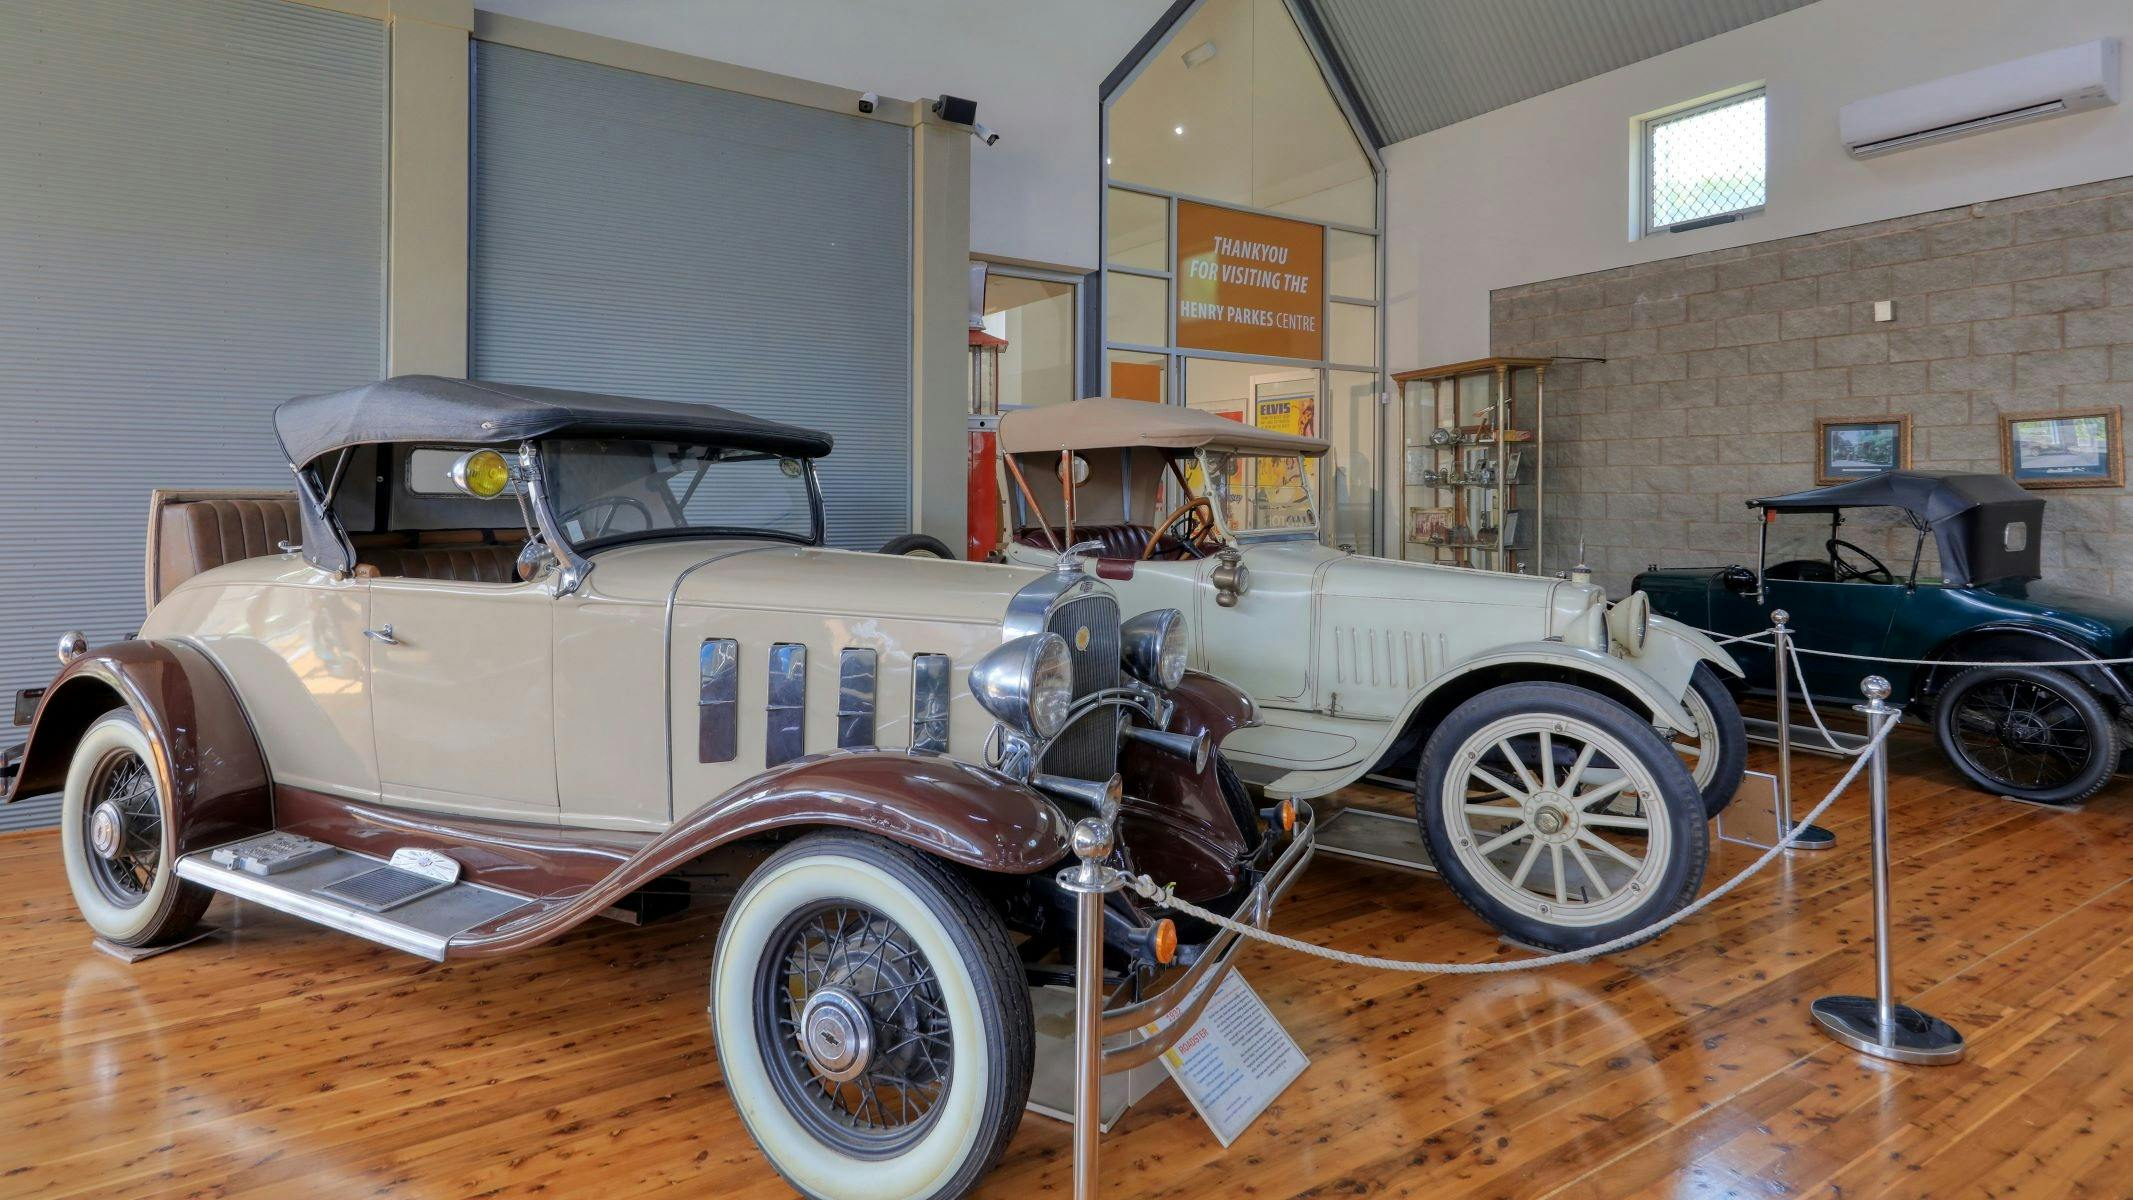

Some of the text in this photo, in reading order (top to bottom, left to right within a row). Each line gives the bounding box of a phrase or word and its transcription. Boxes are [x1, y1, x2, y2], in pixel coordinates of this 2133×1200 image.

[1213, 235, 1288, 264] THANKYOU
[1190, 259, 1309, 293] FOR VISITING THE
[1180, 300, 1316, 332] HENRY PARKES CENTRE
[1260, 402, 1290, 415] ELVIS
[1178, 1027, 1209, 1054] ROADSTER
